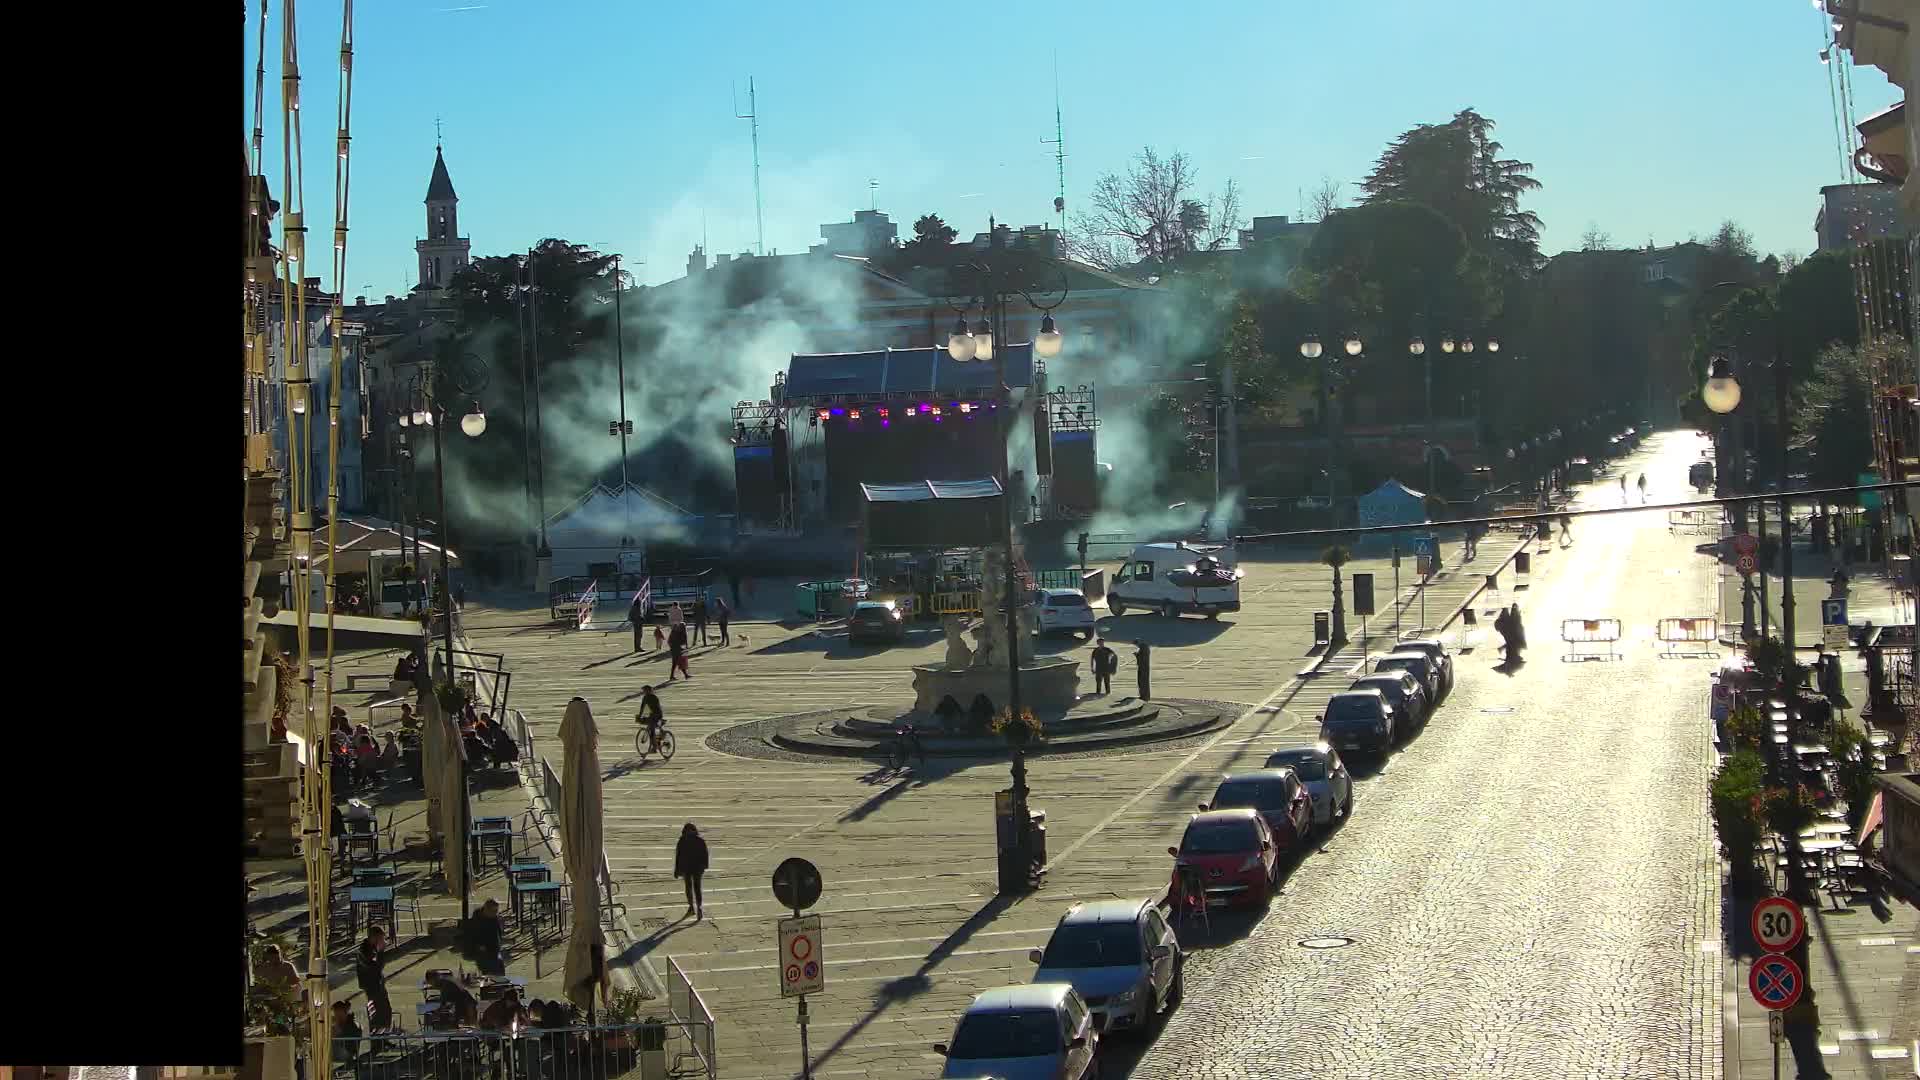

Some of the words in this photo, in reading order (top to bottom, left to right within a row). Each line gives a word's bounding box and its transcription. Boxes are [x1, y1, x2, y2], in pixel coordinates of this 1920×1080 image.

[1742, 558, 1753, 567] 20
[1827, 602, 1841, 624] P
[1762, 912, 1791, 937] 30
